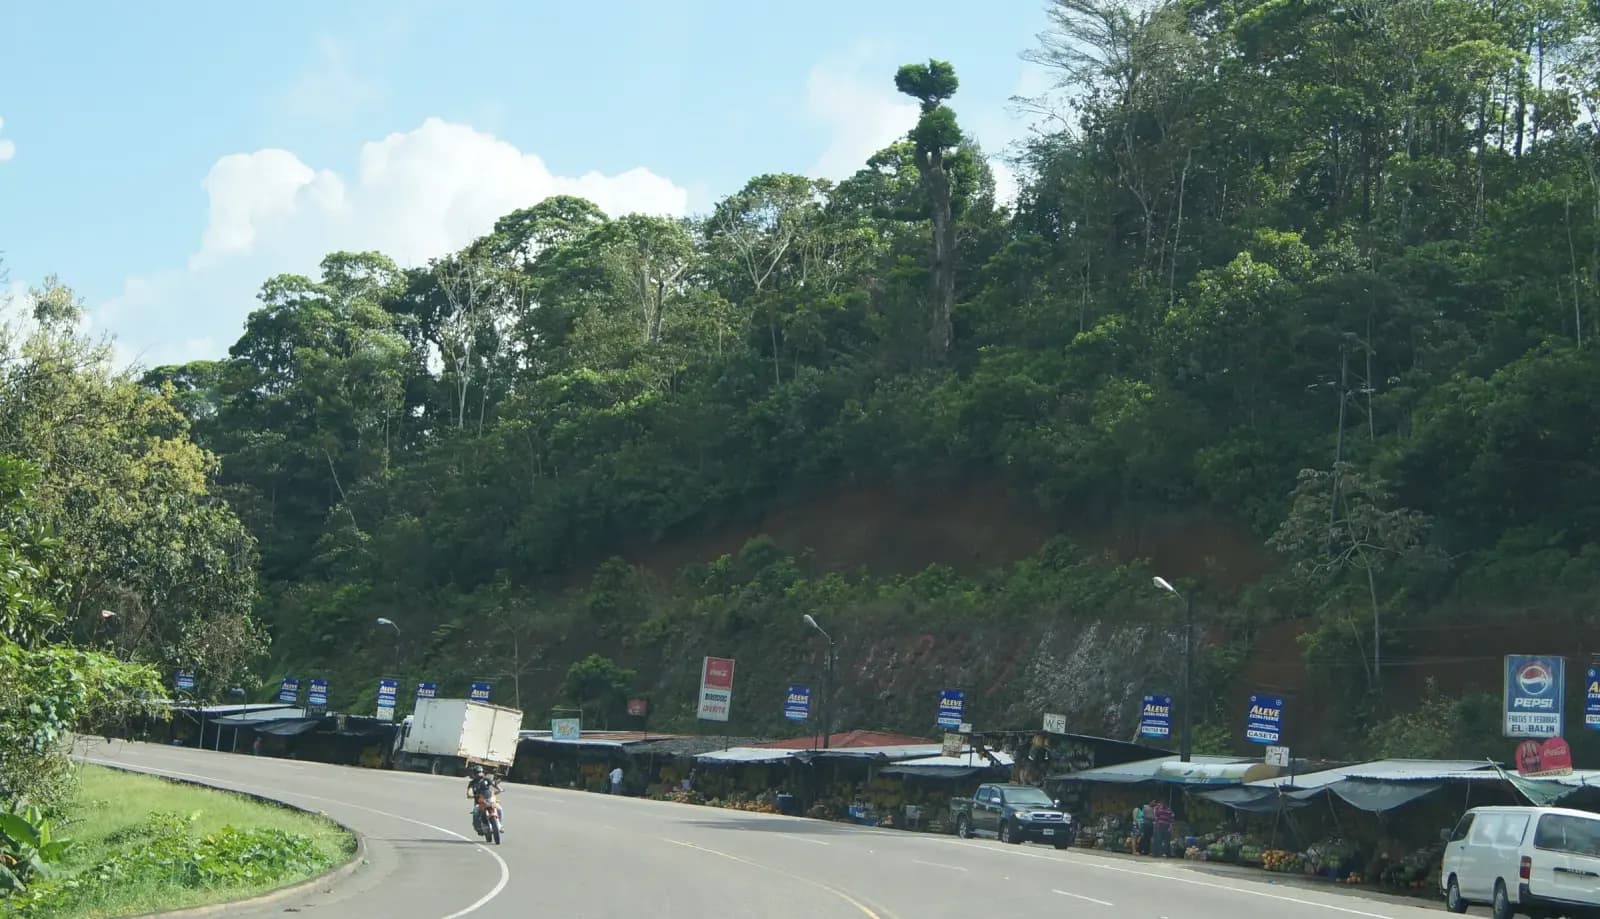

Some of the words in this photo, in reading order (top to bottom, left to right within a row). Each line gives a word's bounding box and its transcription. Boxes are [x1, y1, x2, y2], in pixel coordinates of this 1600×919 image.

[788, 693, 808, 702] ALEVE
[941, 697, 963, 707] ALEVE
[1514, 697, 1553, 708] PEPSI
[1144, 704, 1169, 714] ALEVE
[1250, 704, 1280, 717] ALEVE
[1511, 724, 1524, 733] EL
[1528, 724, 1555, 734] BALIN
[1248, 730, 1278, 740] CASETA
